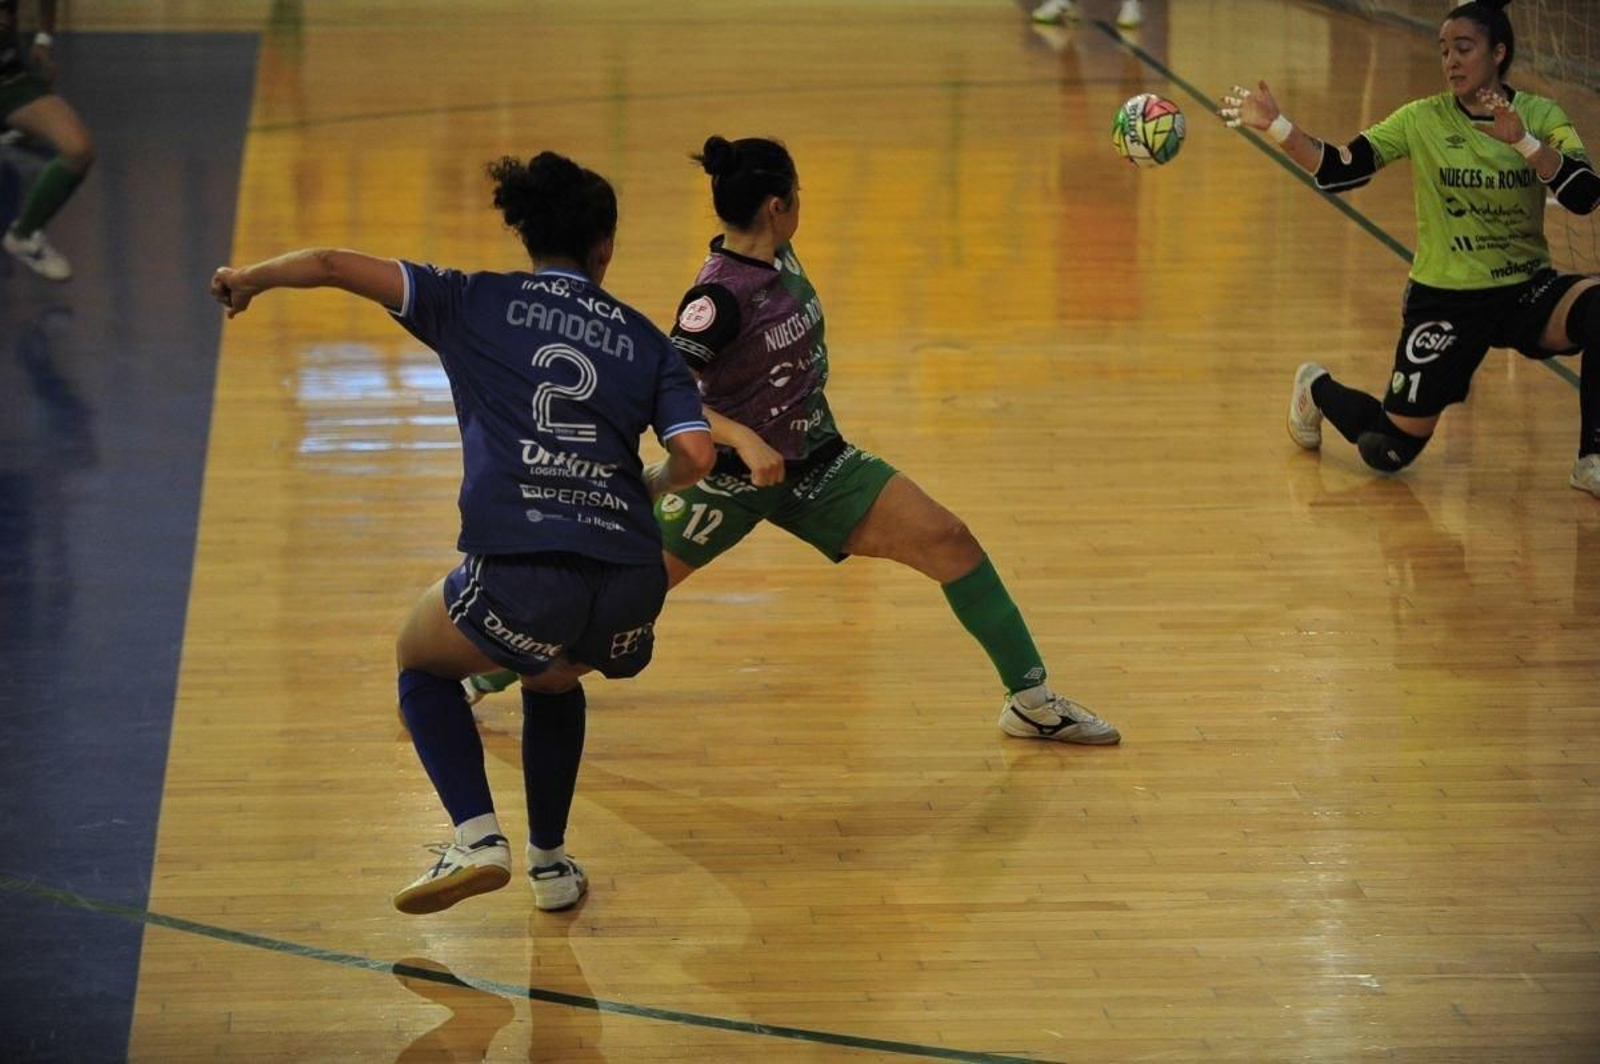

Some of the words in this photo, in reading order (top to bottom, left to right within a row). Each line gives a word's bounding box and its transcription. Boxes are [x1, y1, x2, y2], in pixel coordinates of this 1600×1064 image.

[1440, 167, 1482, 188] NUECES
[506, 299, 635, 362] CANDELA
[531, 342, 598, 442] 2
[1408, 371, 1422, 403] 1
[682, 503, 724, 545] 12
